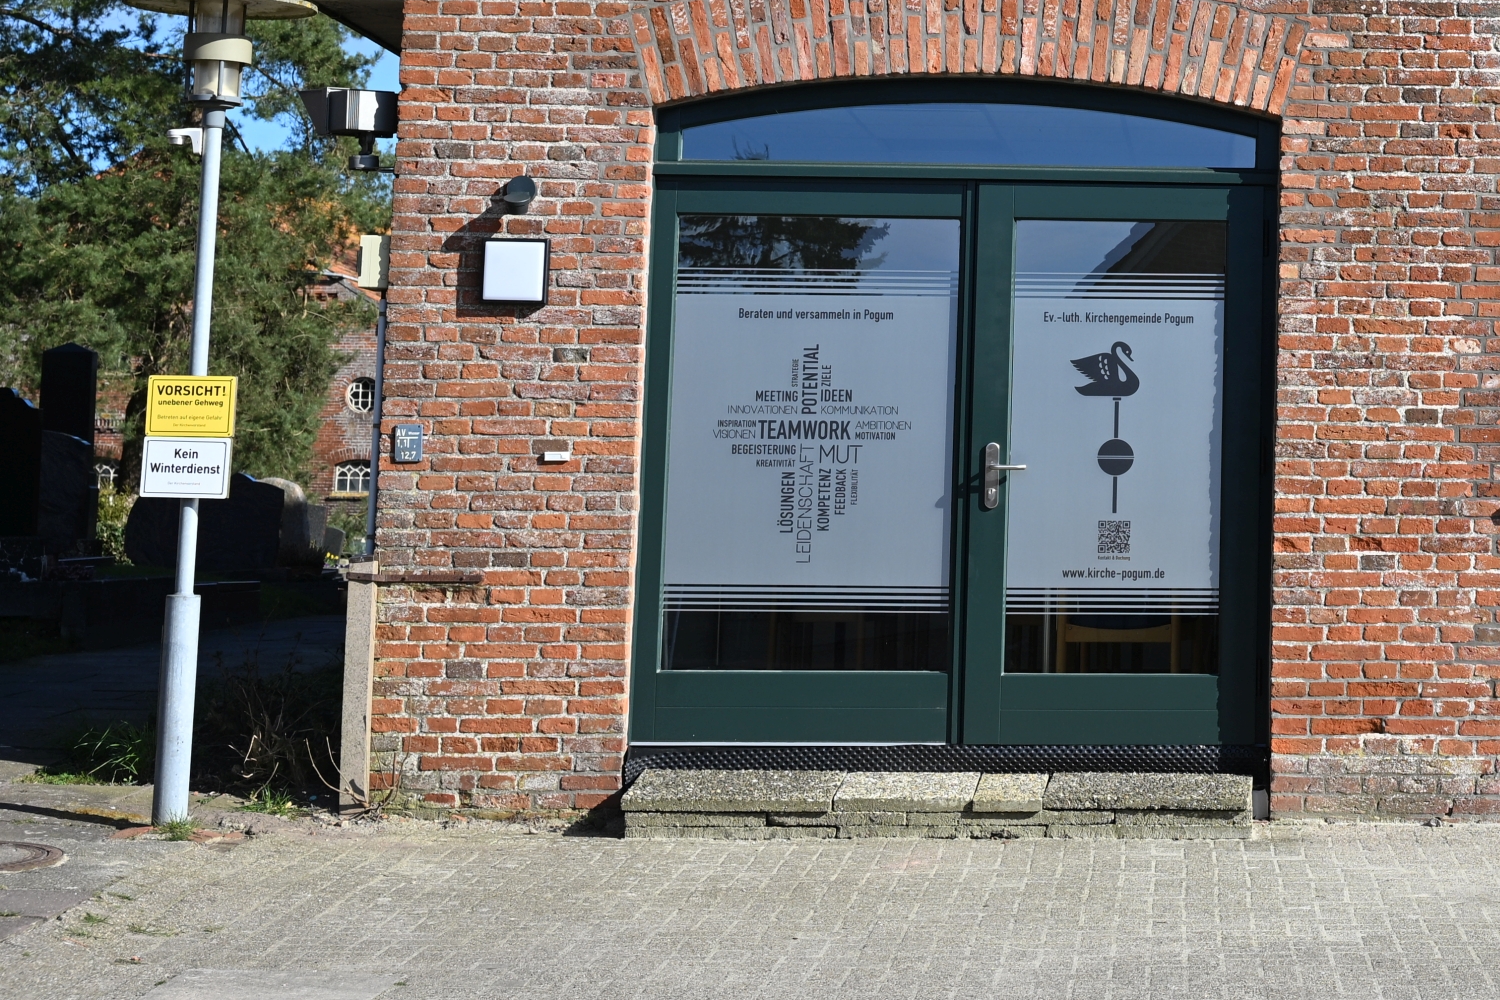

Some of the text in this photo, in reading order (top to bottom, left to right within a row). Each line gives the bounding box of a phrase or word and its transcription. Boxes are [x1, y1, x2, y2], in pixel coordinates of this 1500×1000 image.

[739, 308, 894, 322] Beraten und versammeln in Pogum
[1044, 312, 1194, 326] Ev.-luth. Kirchengemeinde Pogum
[791, 359, 799, 388] STRATEGIE
[801, 344, 819, 414] POTENTIAL
[821, 365, 832, 387] ZIELE
[157, 385, 226, 396] VORSICHT!
[755, 390, 798, 402] MEETING
[821, 389, 852, 402] IDEEN
[195, 399, 224, 408] Gehweg
[727, 405, 798, 414] INNOVATIONEN
[821, 405, 898, 415] KOMMUNIKATION
[718, 420, 756, 428] INSPIRATION
[758, 420, 851, 440] TEAMWORK
[855, 421, 912, 430] AMBITIONEN
[713, 429, 756, 439] VISIONEN
[855, 432, 896, 440] MOTIVATION
[174, 448, 199, 459] Kein
[401, 451, 416, 460] 12,7
[731, 444, 796, 455] BEGEISTERUNG
[819, 444, 863, 464] MUT
[150, 462, 220, 474] Winterdienst
[756, 458, 796, 468] KREATIVITÄT
[834, 469, 846, 515] FEEDBACK
[850, 469, 858, 506] FLEXIBILITÄT
[777, 472, 795, 533] LÖSUNGEN
[796, 443, 814, 563] LEIDENSCHAFT
[817, 468, 831, 531] KOMPETENZ
[1062, 567, 1165, 581] www.kirche-pogum.de
